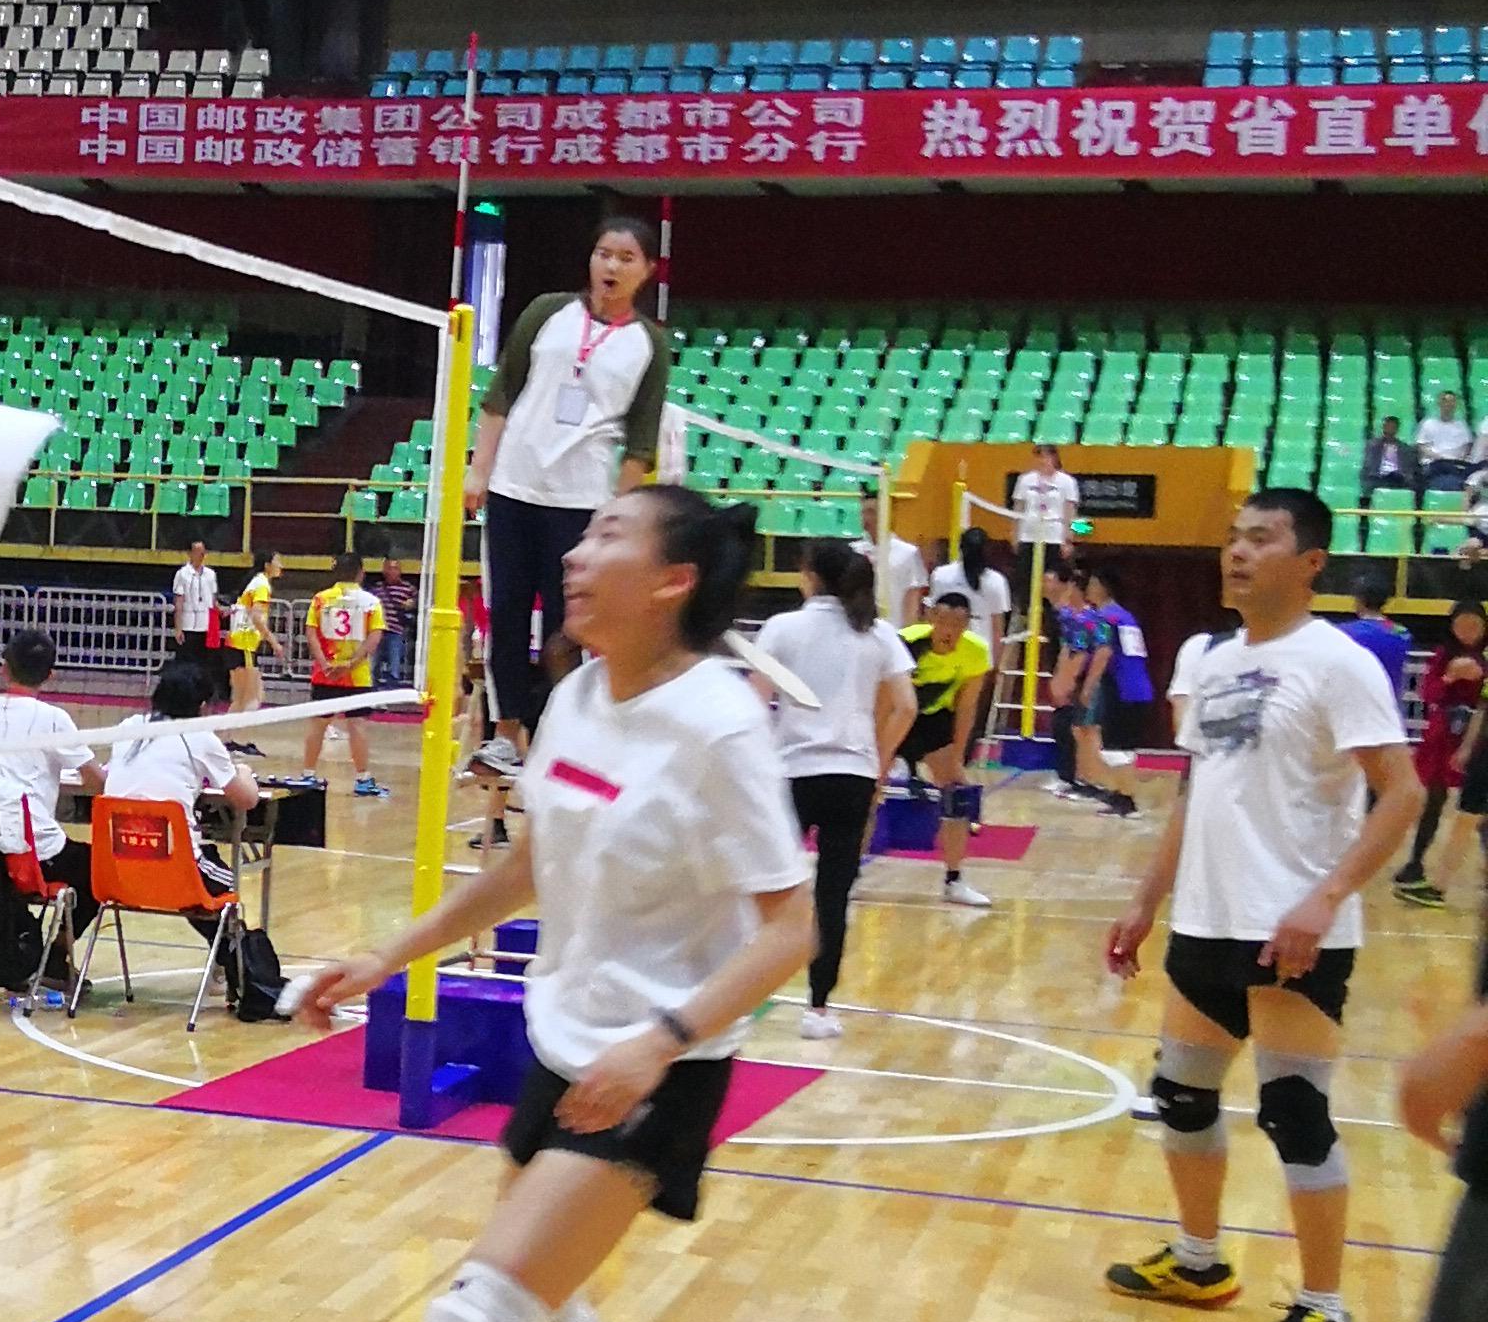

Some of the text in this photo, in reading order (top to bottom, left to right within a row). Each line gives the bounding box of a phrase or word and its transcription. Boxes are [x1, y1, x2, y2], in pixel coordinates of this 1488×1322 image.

[80, 97, 865, 134] 中国邮政集团公司成都市公司
[334, 609, 352, 637] 3
